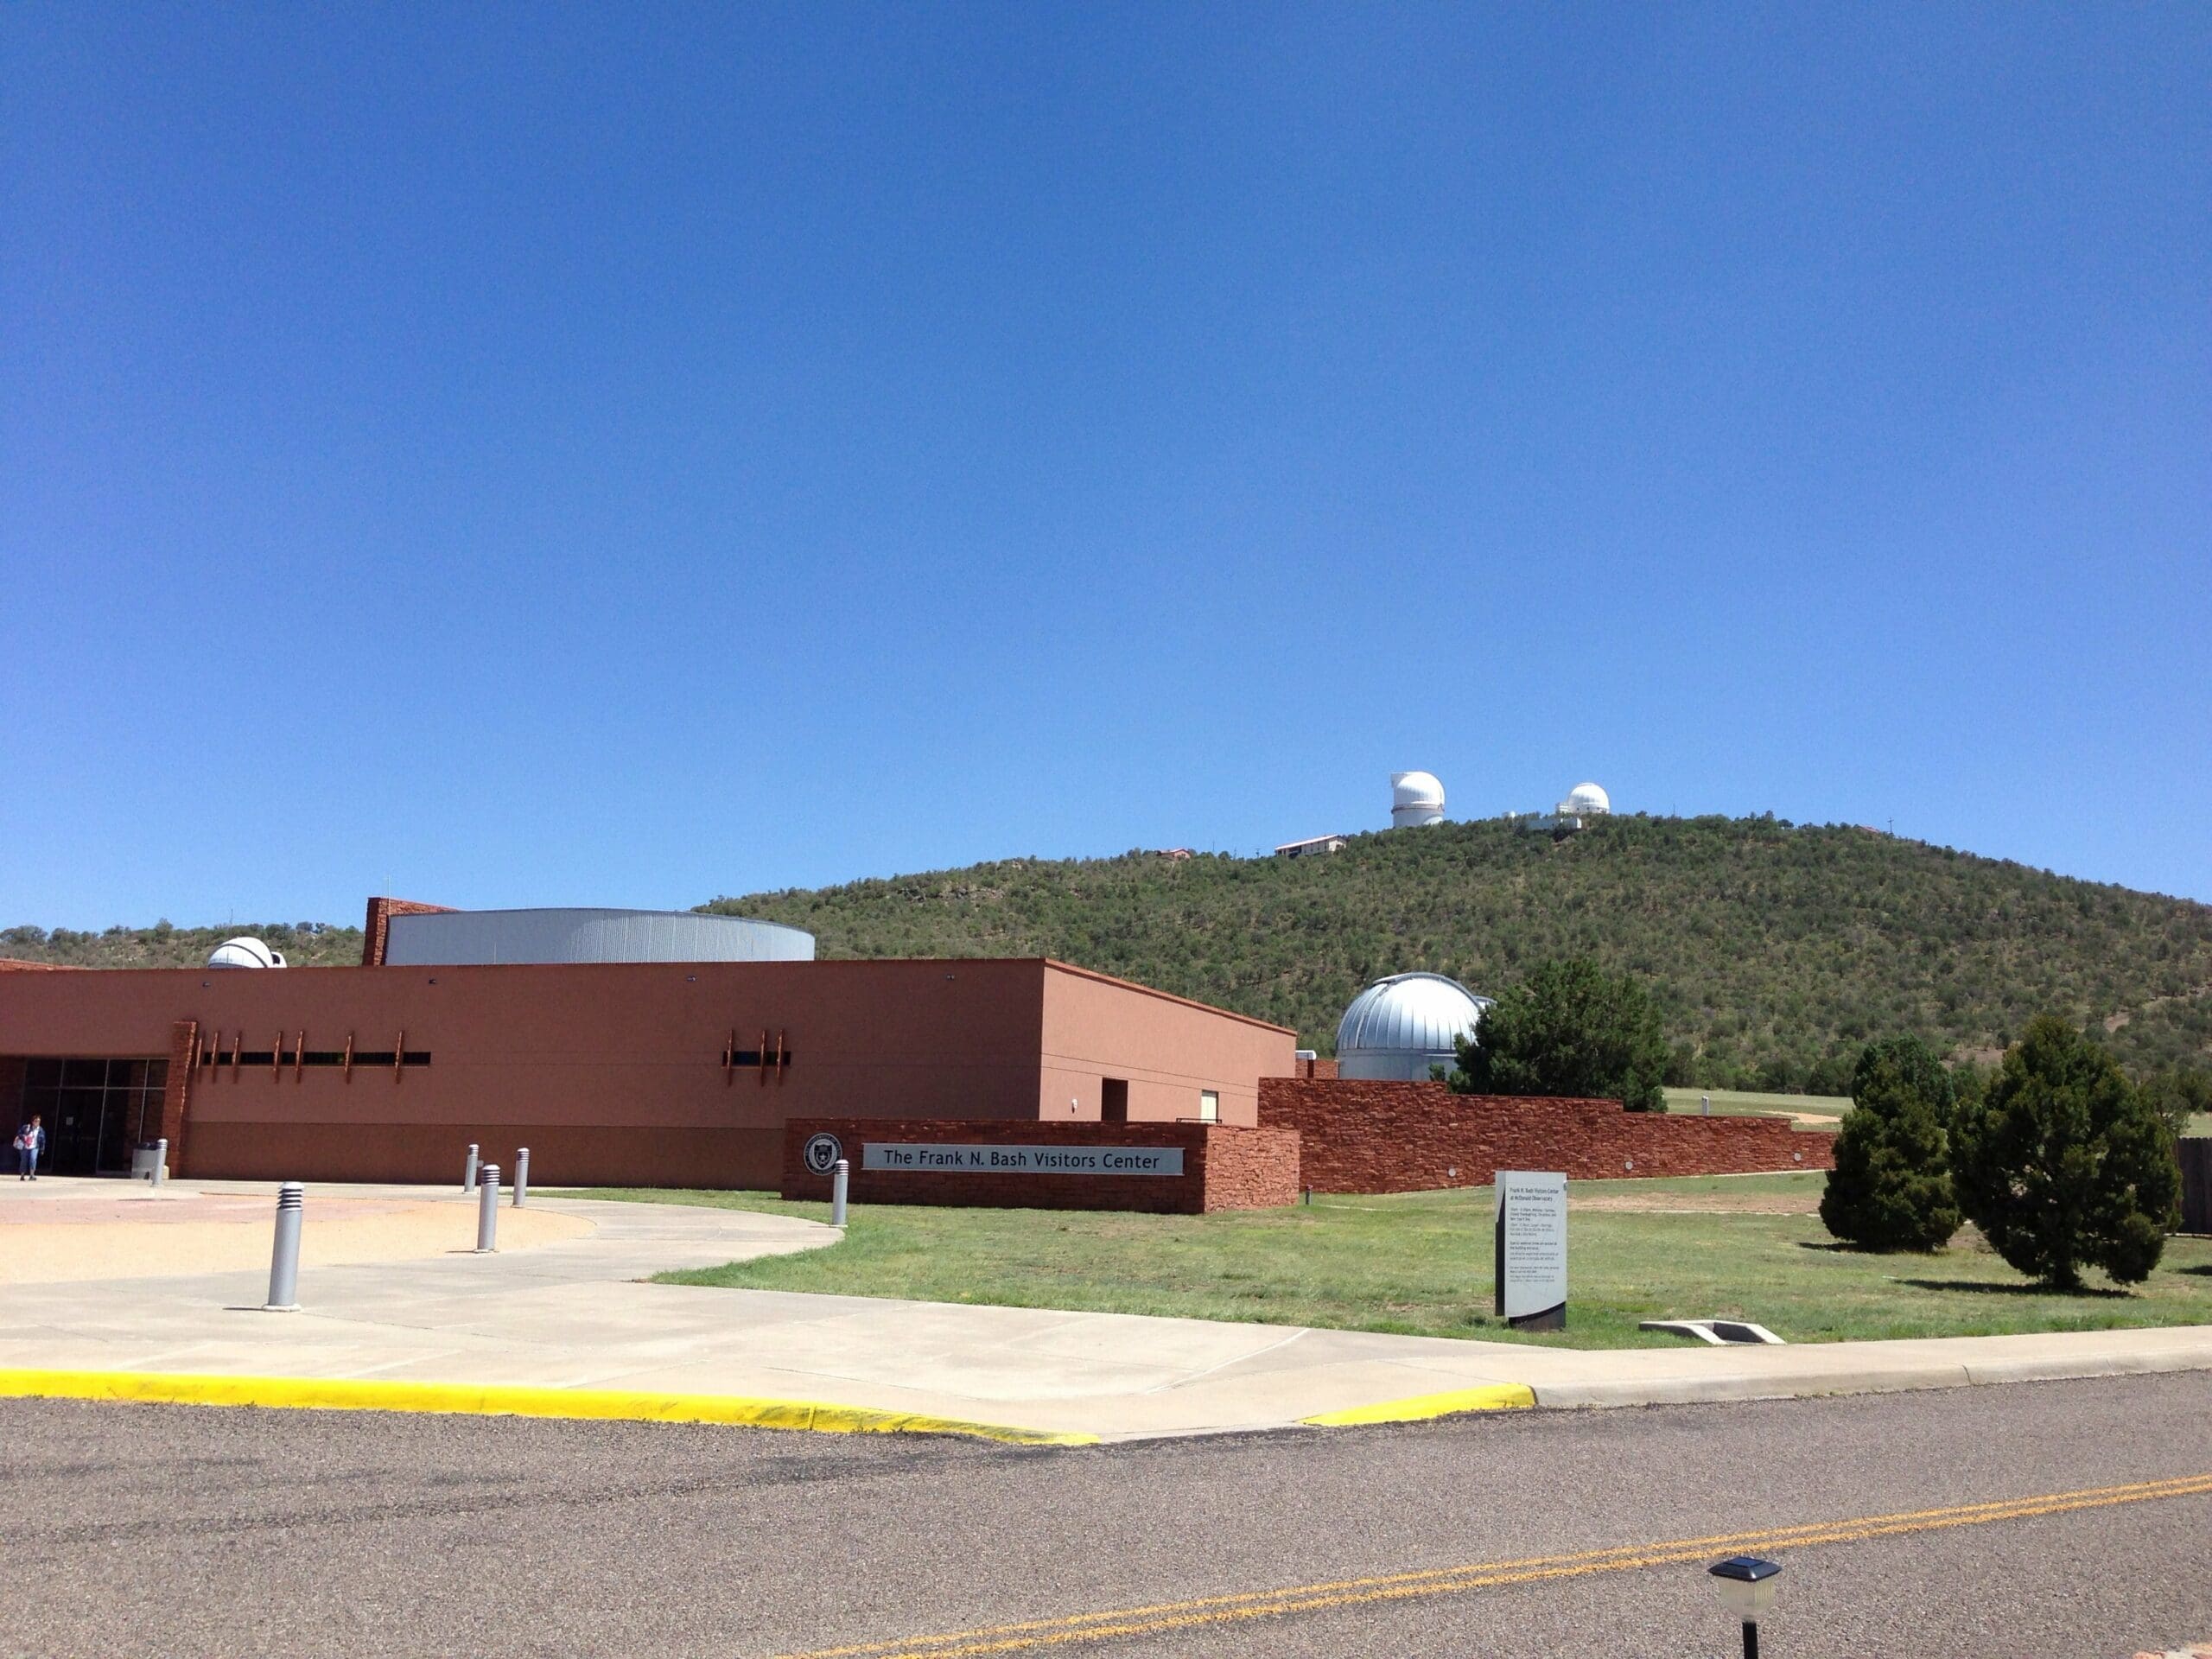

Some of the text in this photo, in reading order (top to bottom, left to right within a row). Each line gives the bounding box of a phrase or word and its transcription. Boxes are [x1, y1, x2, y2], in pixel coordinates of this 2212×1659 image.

[884, 1149, 1160, 1169] The Frank N. Bash Visitors Center
